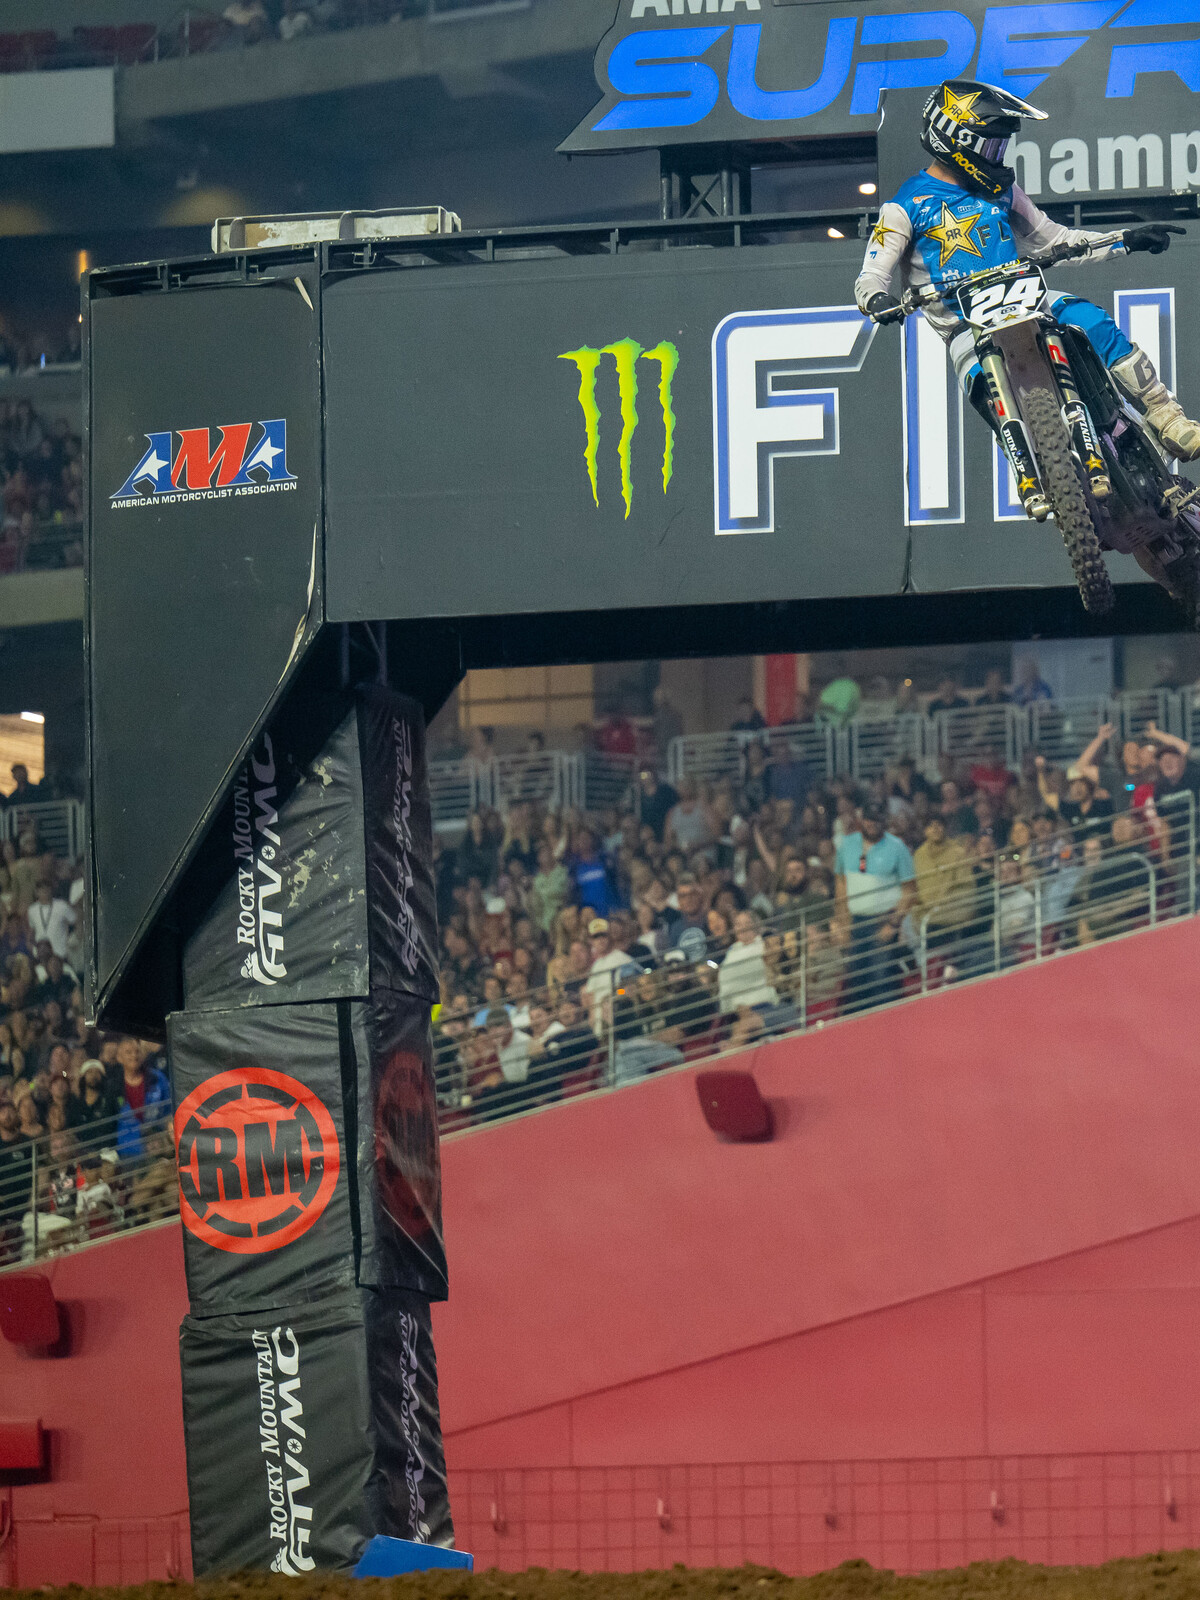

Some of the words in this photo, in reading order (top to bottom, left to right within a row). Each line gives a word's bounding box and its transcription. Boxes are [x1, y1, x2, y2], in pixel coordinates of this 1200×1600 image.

[970, 276, 1044, 328] 24
[109, 418, 299, 499] AMA
[111, 497, 160, 509] AMERICAN
[161, 489, 233, 504] MOTORCYCLIST
[234, 482, 298, 496] ASSOCIATION
[236, 866, 257, 947] ROCKY
[251, 1329, 281, 1457] MOUNTAIN
[266, 1460, 288, 1542] ROCKY
